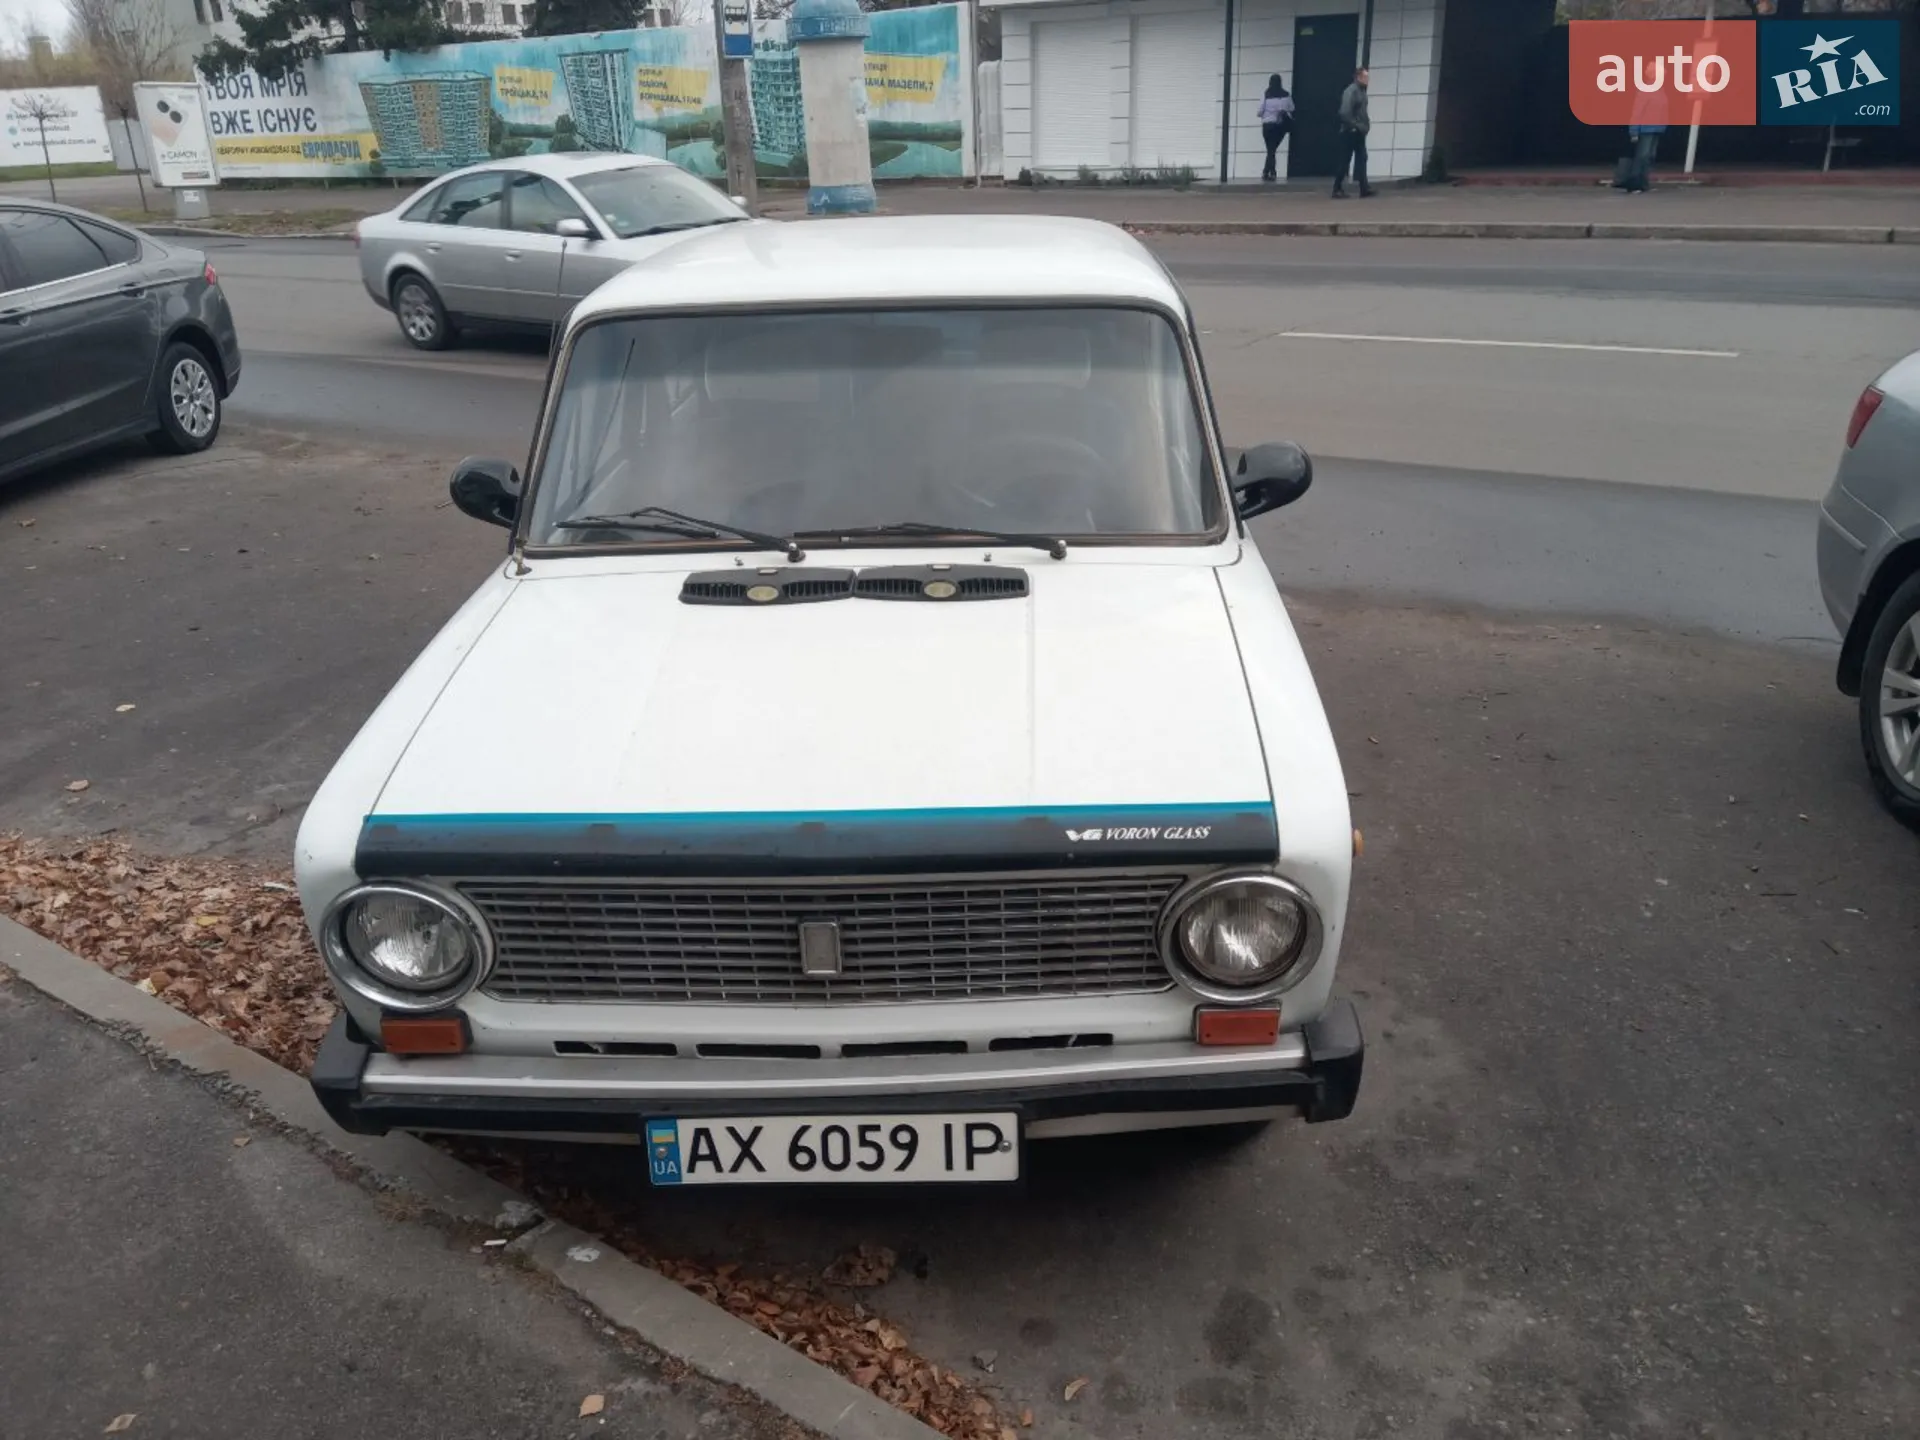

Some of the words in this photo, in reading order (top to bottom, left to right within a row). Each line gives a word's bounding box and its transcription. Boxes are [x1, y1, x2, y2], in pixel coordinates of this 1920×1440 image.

[210, 110, 254, 134] ВЖЕ
[257, 107, 317, 133] ІСНУЄ
[1106, 827, 1161, 841] VORON
[1163, 826, 1211, 840] GLASS
[687, 1126, 767, 1173] AX
[788, 1123, 919, 1172] 6059
[944, 1122, 1005, 1171] IP
[654, 1161, 678, 1176] UA
